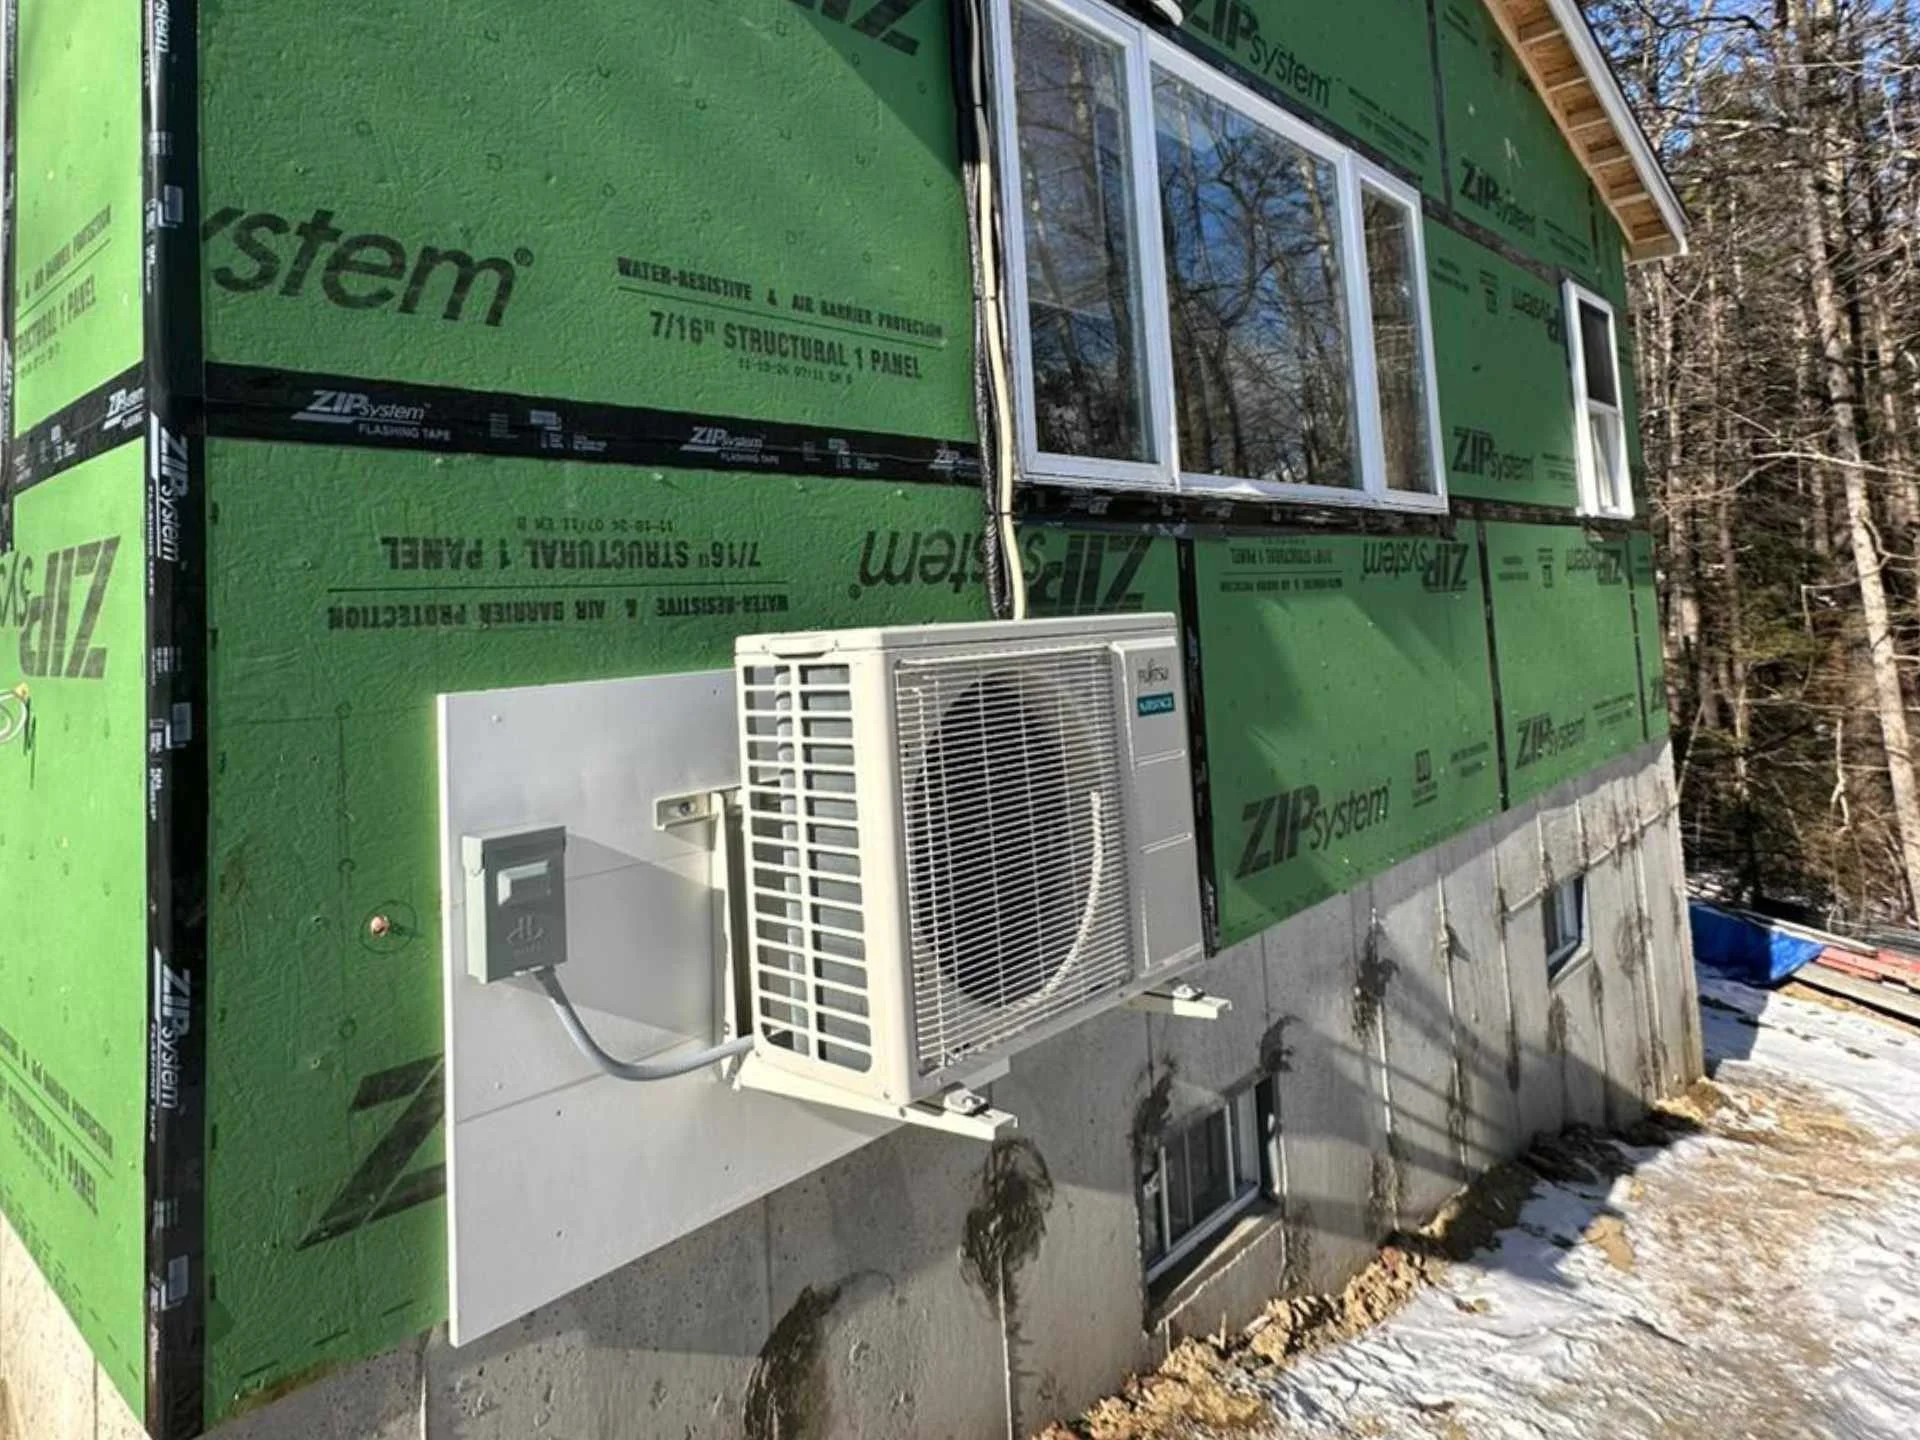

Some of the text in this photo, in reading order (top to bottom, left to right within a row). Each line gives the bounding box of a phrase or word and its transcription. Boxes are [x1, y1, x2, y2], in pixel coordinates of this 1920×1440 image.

[617, 256, 944, 339] WATER-RESISTIVE & AIR BARRIER PROTECTION
[649, 310, 923, 379] 7/16" STRUCTURAL 1 PANEL
[380, 536, 762, 571] 7/16" STRUCTURAL 1 PANEL
[328, 593, 790, 631] WATER-RESISTIVE & AIR BARRIER PROTECTION
